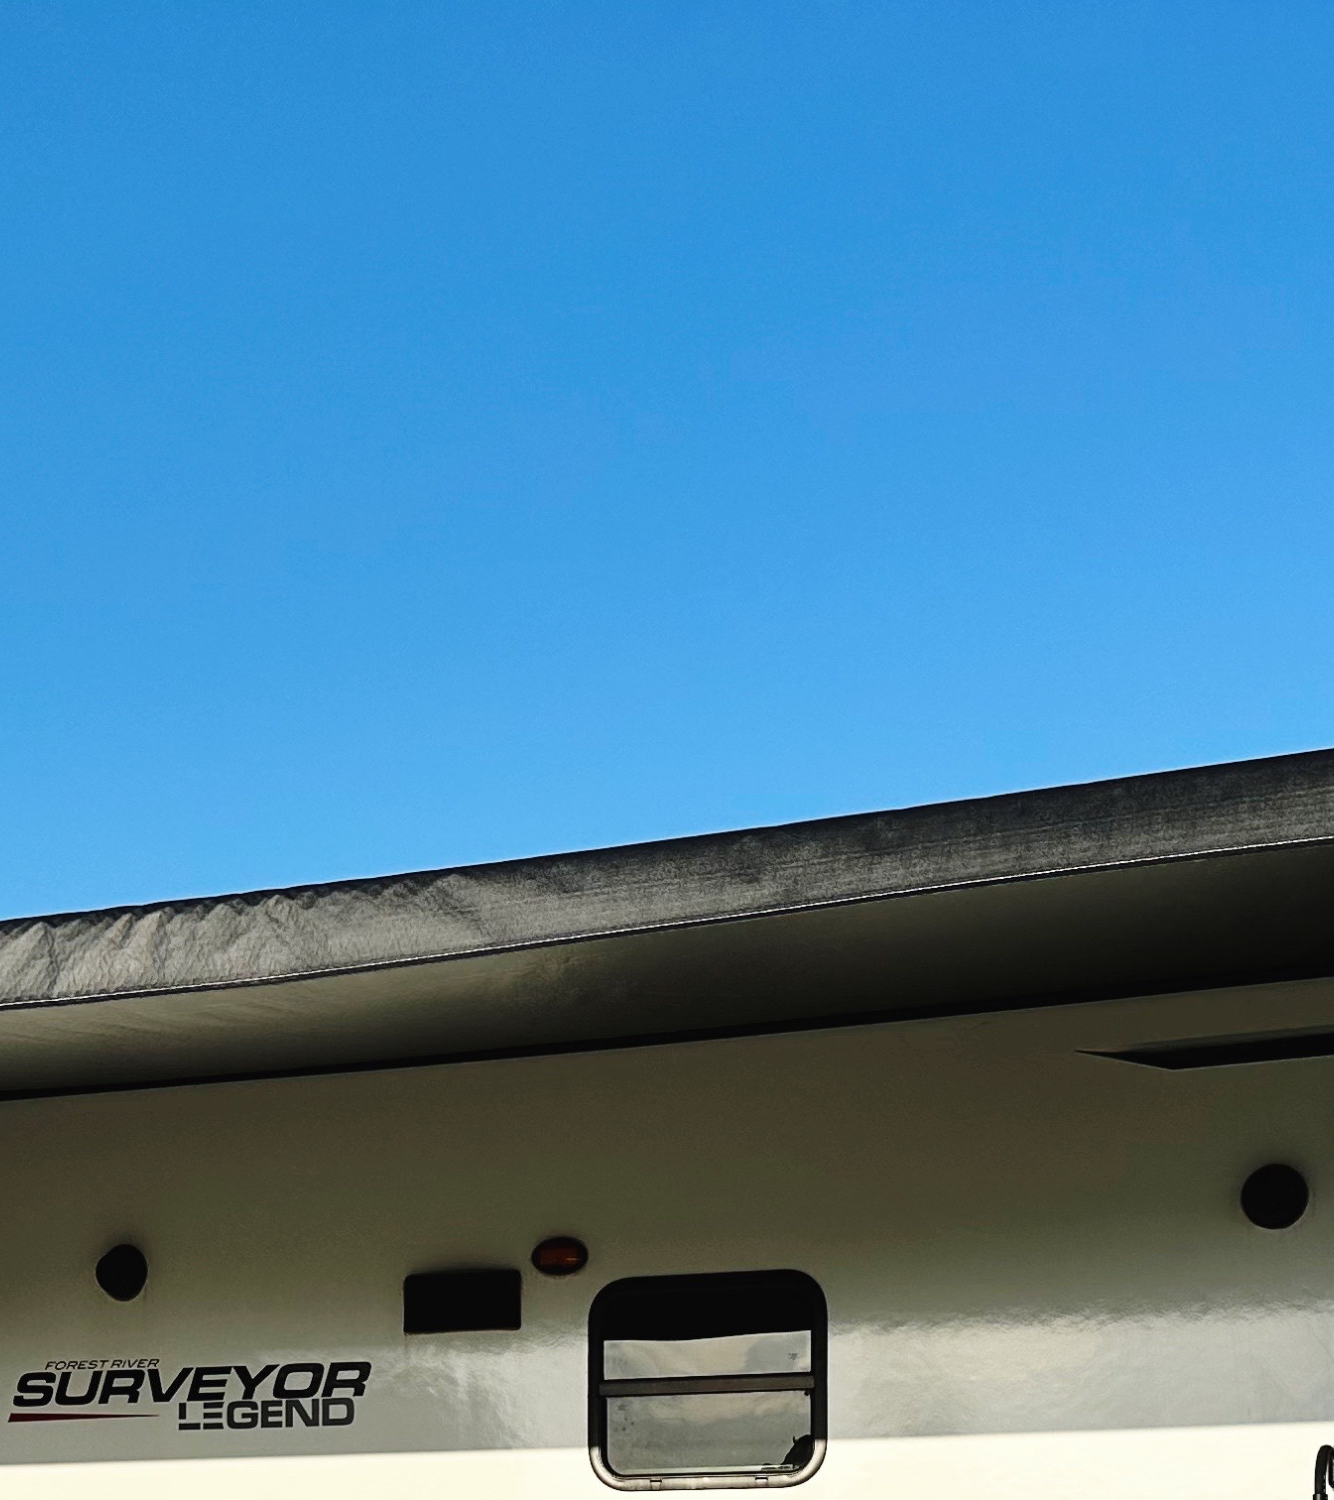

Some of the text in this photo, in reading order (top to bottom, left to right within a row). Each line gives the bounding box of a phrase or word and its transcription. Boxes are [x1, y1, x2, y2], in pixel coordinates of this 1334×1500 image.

[45, 1358, 160, 1370] FOREST RIVER
[12, 1361, 372, 1407] SURVEYOR
[178, 1398, 356, 1430] LEGEND
